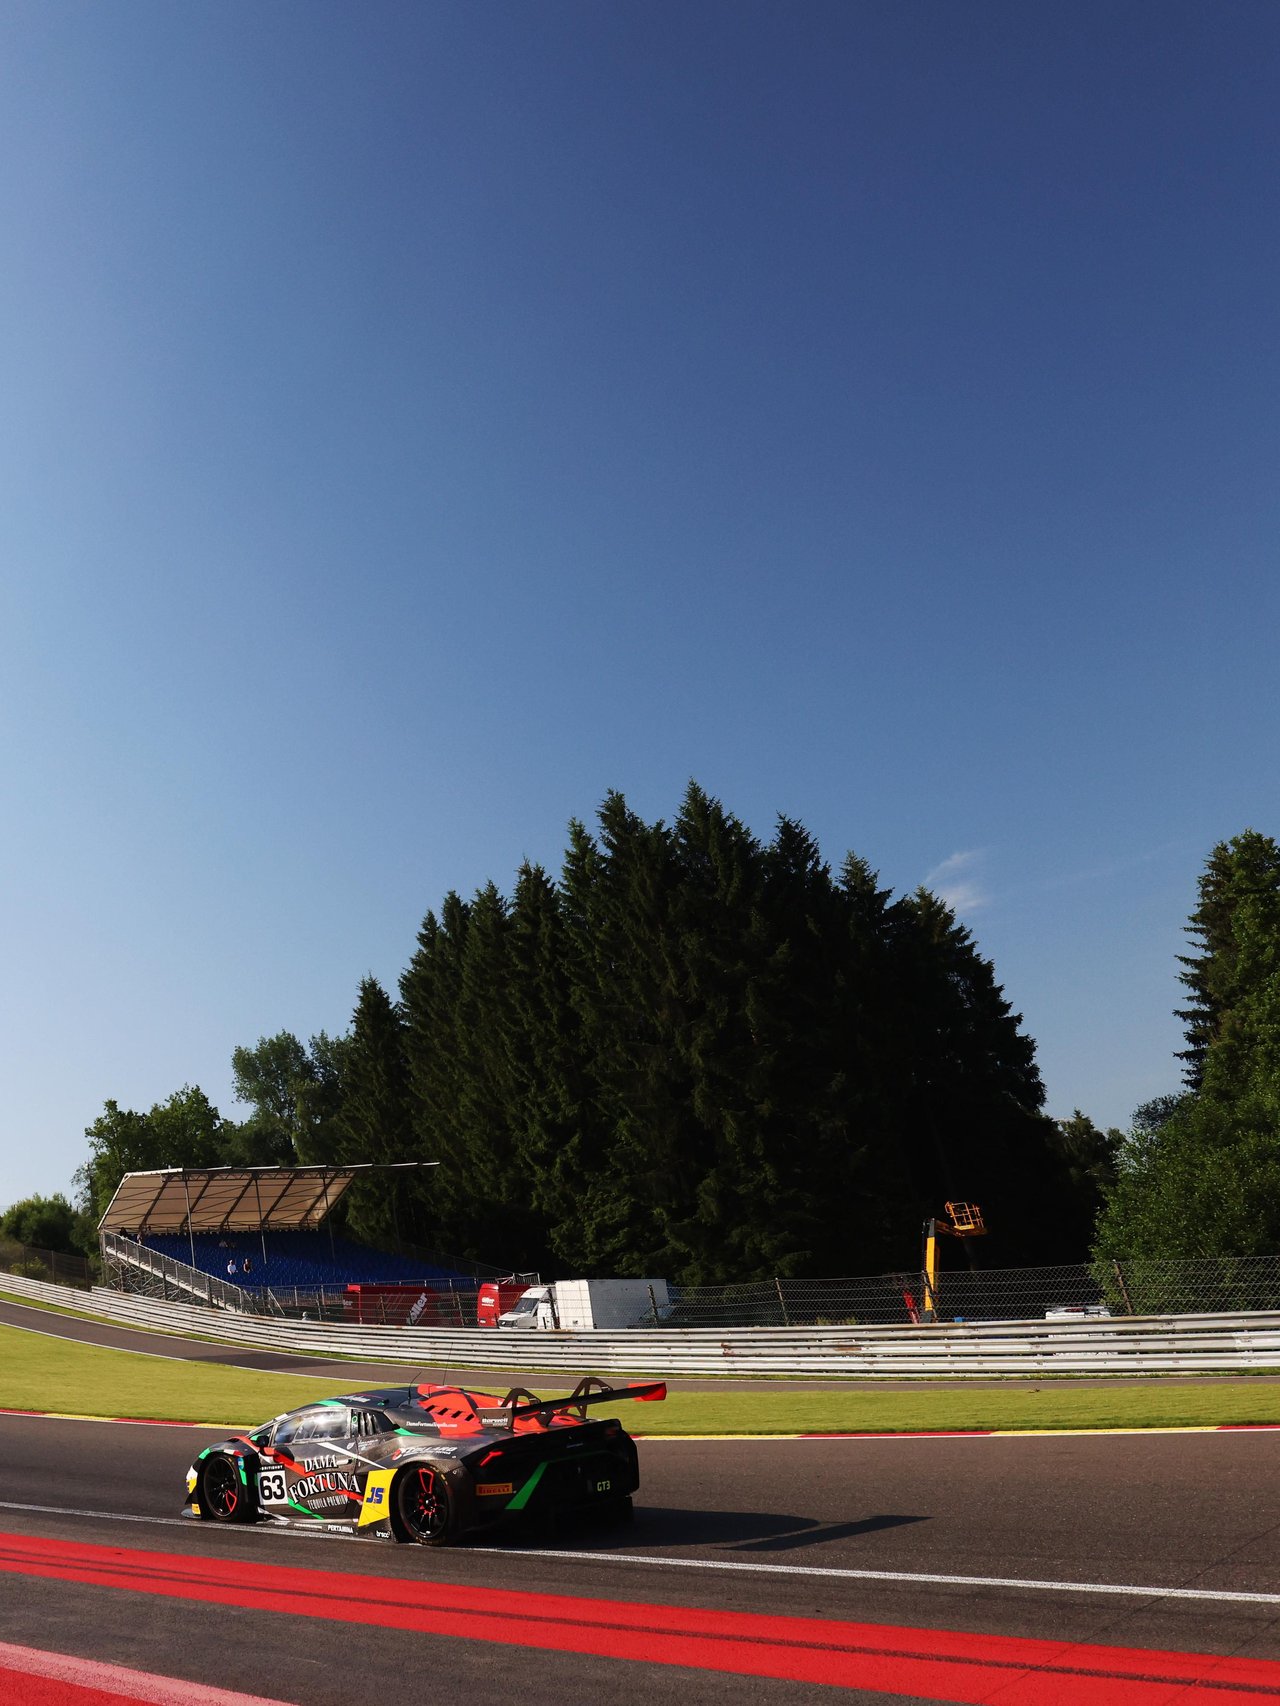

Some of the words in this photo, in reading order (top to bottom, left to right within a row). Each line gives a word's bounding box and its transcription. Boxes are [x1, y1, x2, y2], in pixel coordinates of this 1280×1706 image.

[304, 1454, 338, 1473] DAMA
[259, 1474, 285, 1501] 63
[288, 1472, 361, 1504] FORTUNA
[596, 1480, 611, 1492] GT3
[307, 1498, 327, 1510] TEQUILA
[366, 1487, 384, 1504] JS
